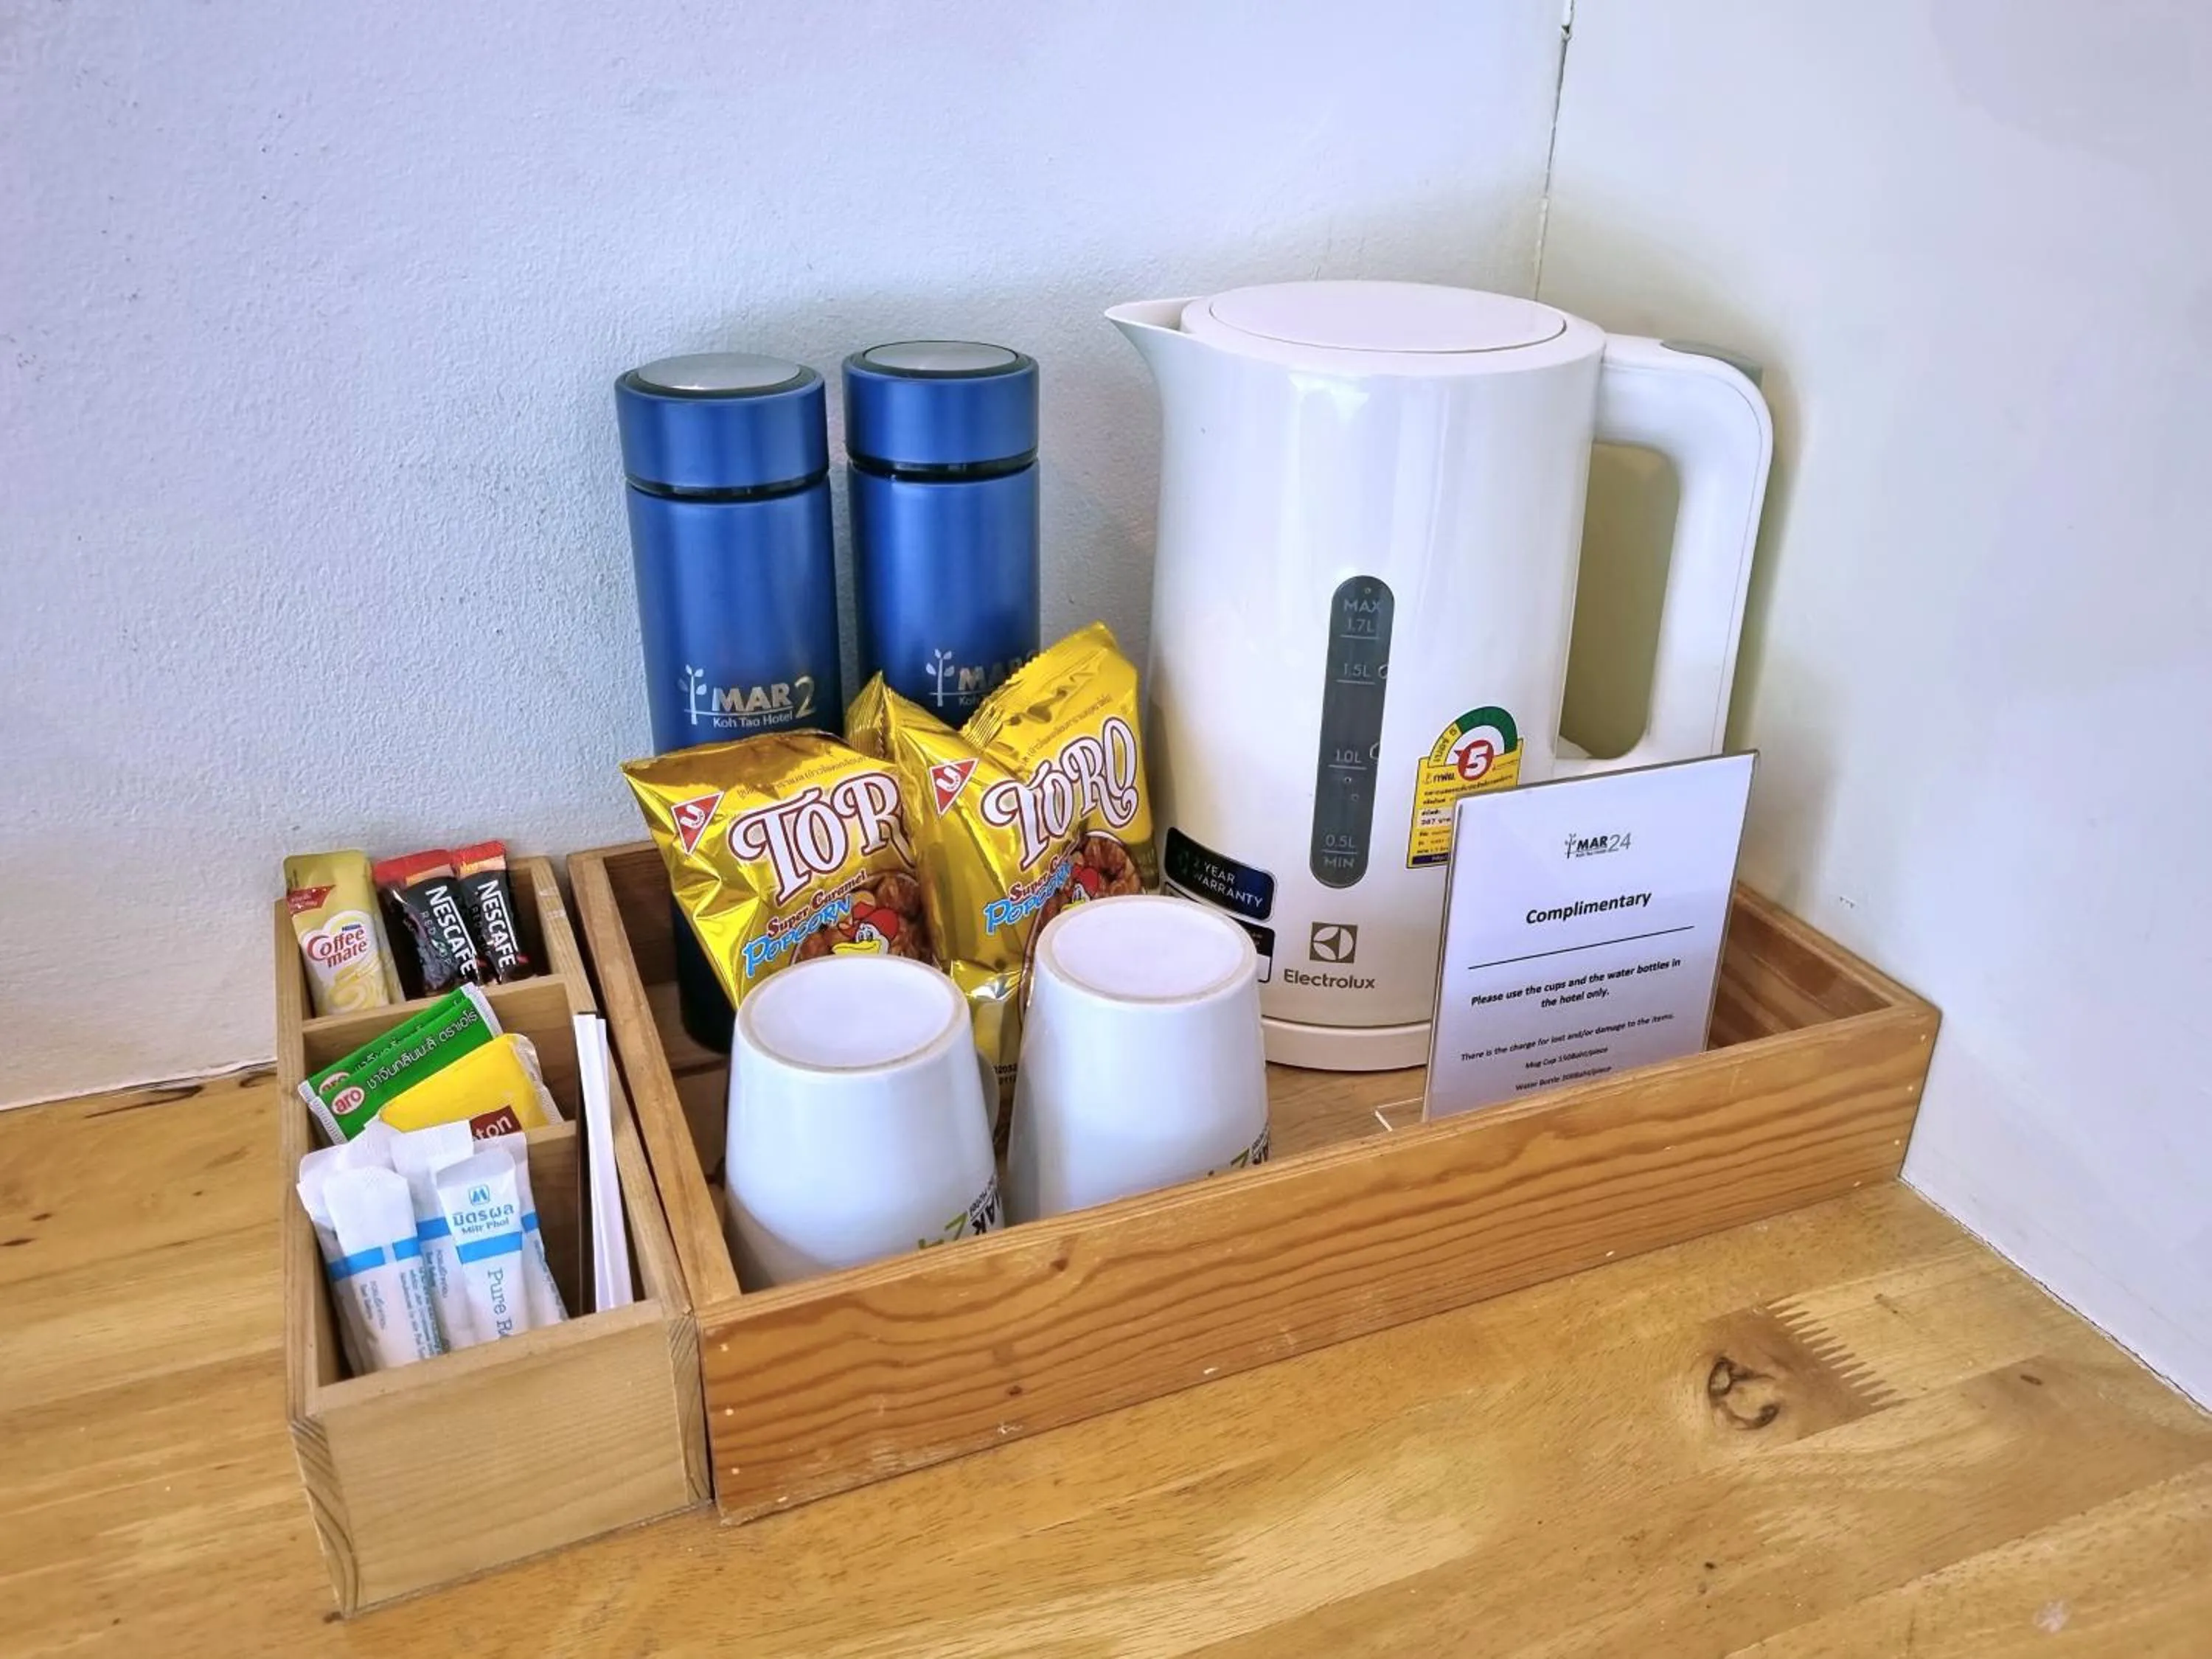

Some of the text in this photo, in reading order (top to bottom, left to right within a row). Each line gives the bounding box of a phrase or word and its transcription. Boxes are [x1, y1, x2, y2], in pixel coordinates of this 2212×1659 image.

[1343, 598, 1380, 613] MAX
[1346, 617, 1374, 633] 1.7L
[1343, 662, 1371, 678] 1.5L
[713, 710, 793, 728] Koh Tao Hotel
[1464, 743, 1490, 779] 5
[981, 716, 1139, 872] TORO
[727, 772, 917, 907] TOR
[1325, 834, 1356, 848] 0.5L
[1204, 861, 1236, 884] YEAR
[1323, 855, 1354, 869] MIN
[768, 867, 868, 938] Super Caramel
[1194, 872, 1264, 908] WARRANTY
[1526, 890, 1652, 925] Complimentary
[307, 928, 365, 961] Coffee
[327, 940, 367, 969] mate
[1284, 968, 1375, 990] Electrolux
[1470, 958, 1681, 1006] Please use the cups and the water bottles in
[1541, 987, 1610, 1008] the hotel only.
[1461, 1052, 1484, 1061] There
[1495, 1046, 1508, 1055] the
[1509, 1040, 1536, 1052] charge
[1538, 1037, 1549, 1046] for
[1551, 1034, 1565, 1043] lost
[1567, 1029, 1593, 1040] and/or
[1595, 1024, 1626, 1035] damage
[1637, 1017, 1650, 1026] the
[1543, 1057, 1557, 1067] Cup
[335, 1088, 362, 1113] aro
[487, 1267, 507, 1315] Pure
